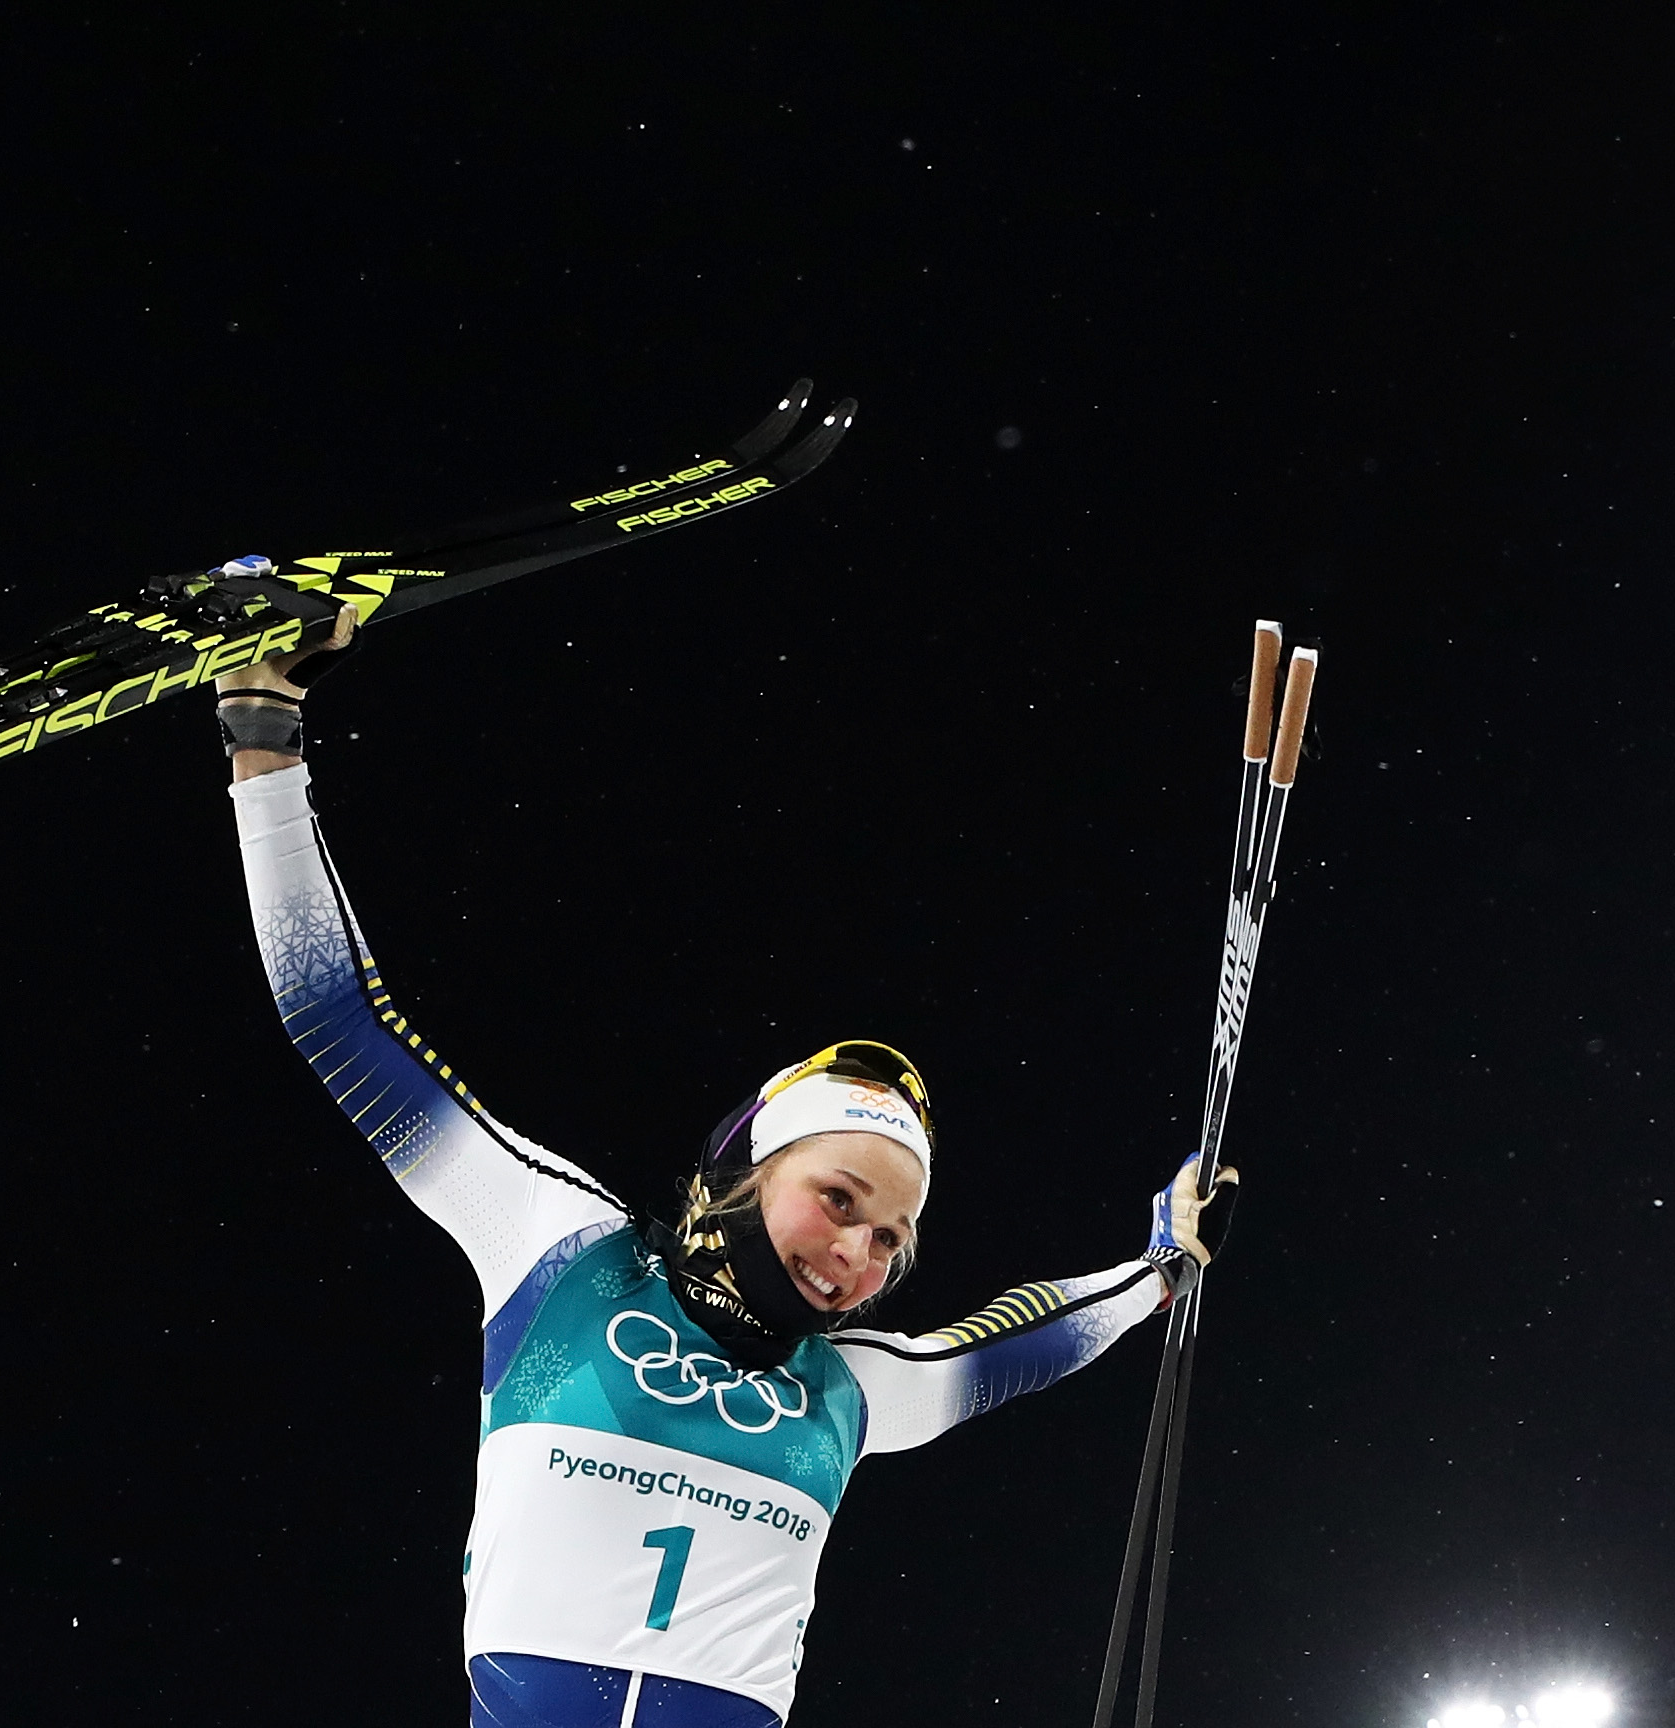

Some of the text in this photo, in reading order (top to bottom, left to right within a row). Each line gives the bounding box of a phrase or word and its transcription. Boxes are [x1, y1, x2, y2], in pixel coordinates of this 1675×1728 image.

[570, 459, 734, 512] FISCHER
[616, 477, 776, 532] FISCHER
[1219, 922, 1258, 1083] SWIX
[845, 1108, 915, 1134] SWE
[548, 1448, 811, 1542] PyeongChang 2018
[642, 1525, 696, 1632] 1
